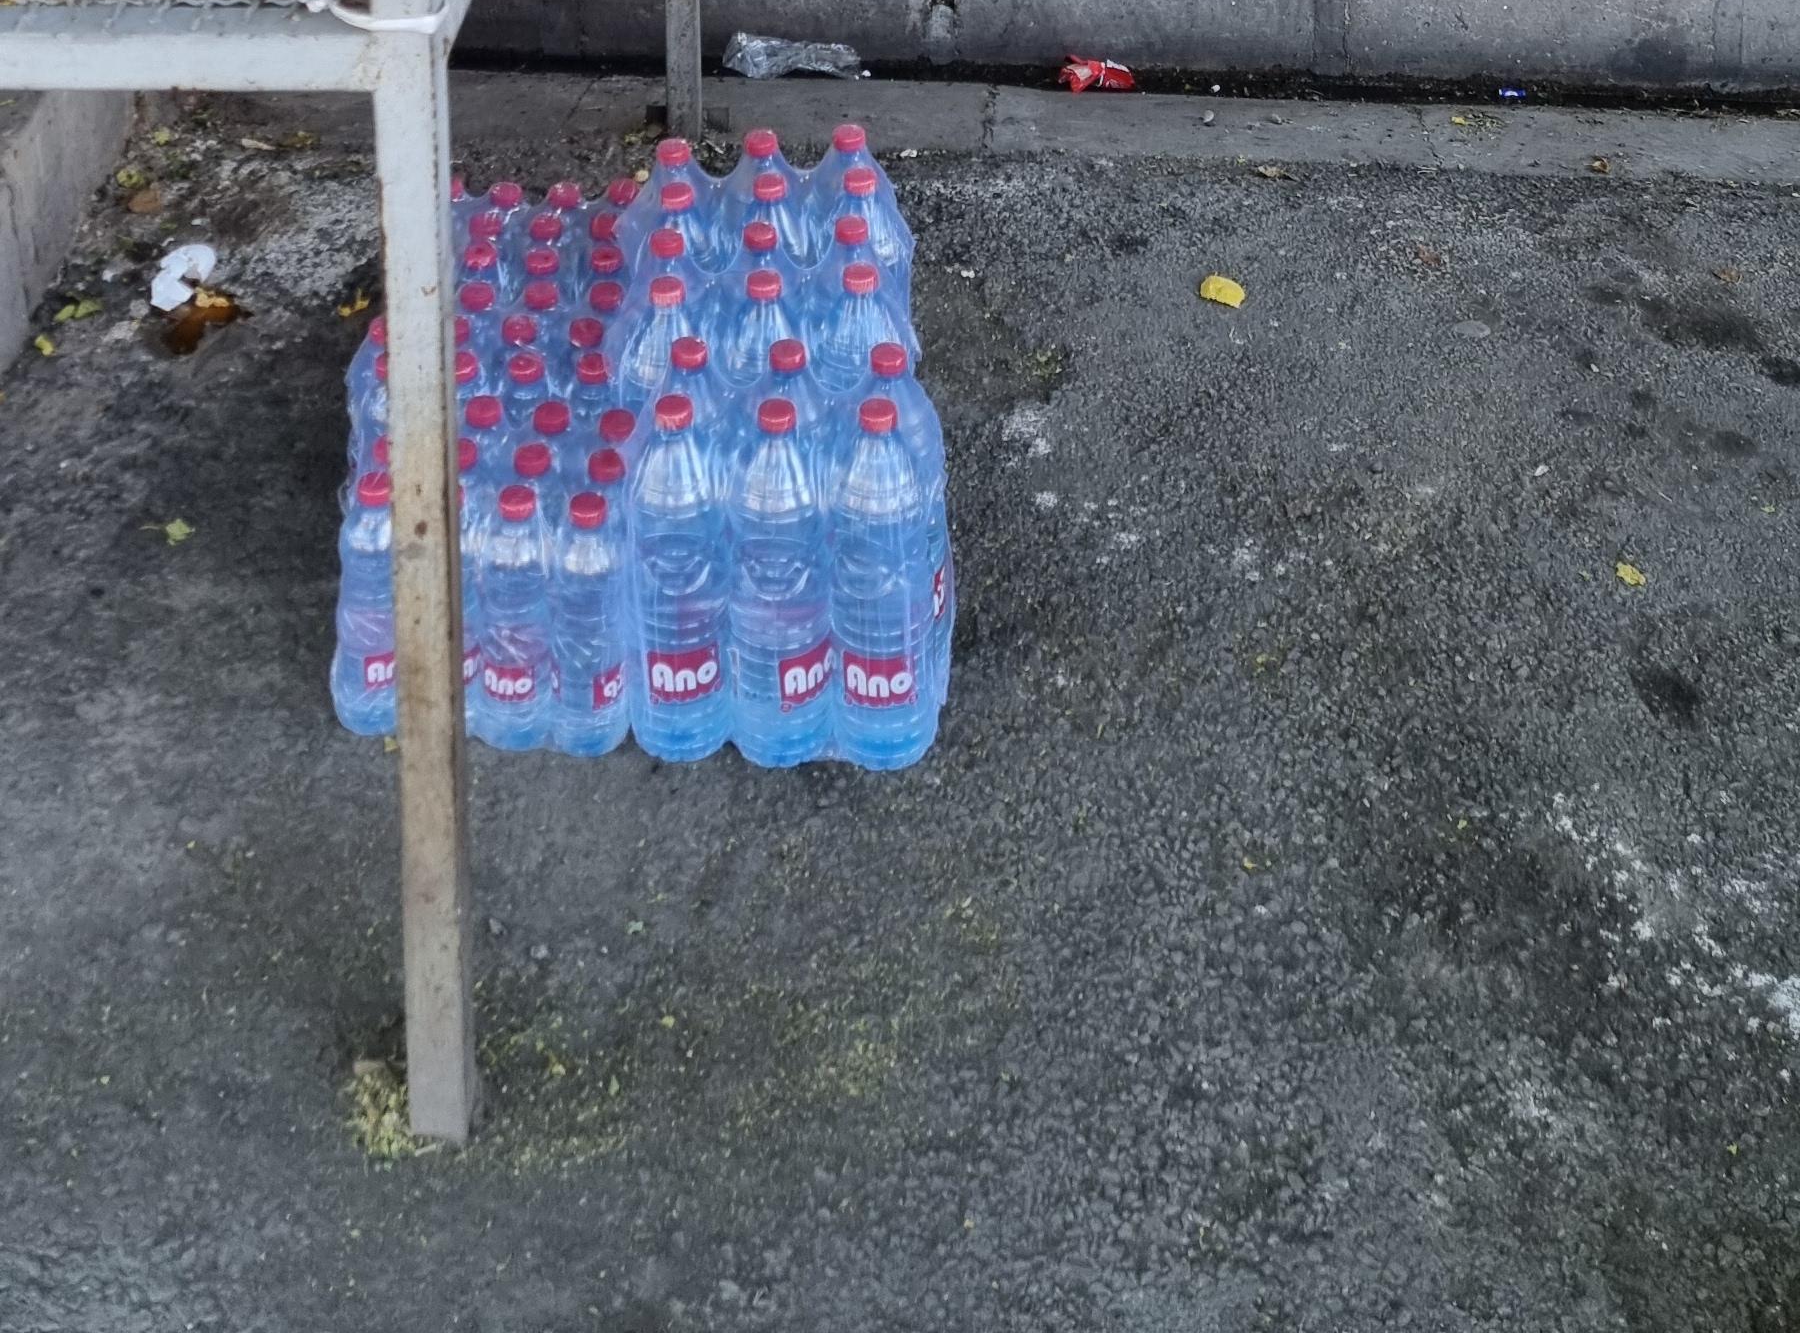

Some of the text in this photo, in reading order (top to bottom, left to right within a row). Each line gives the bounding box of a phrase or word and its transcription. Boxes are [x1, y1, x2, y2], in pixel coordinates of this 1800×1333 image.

[367, 662, 394, 682] An
[484, 667, 532, 696] Ano
[652, 661, 718, 693] Ano
[847, 664, 913, 698] Ano
